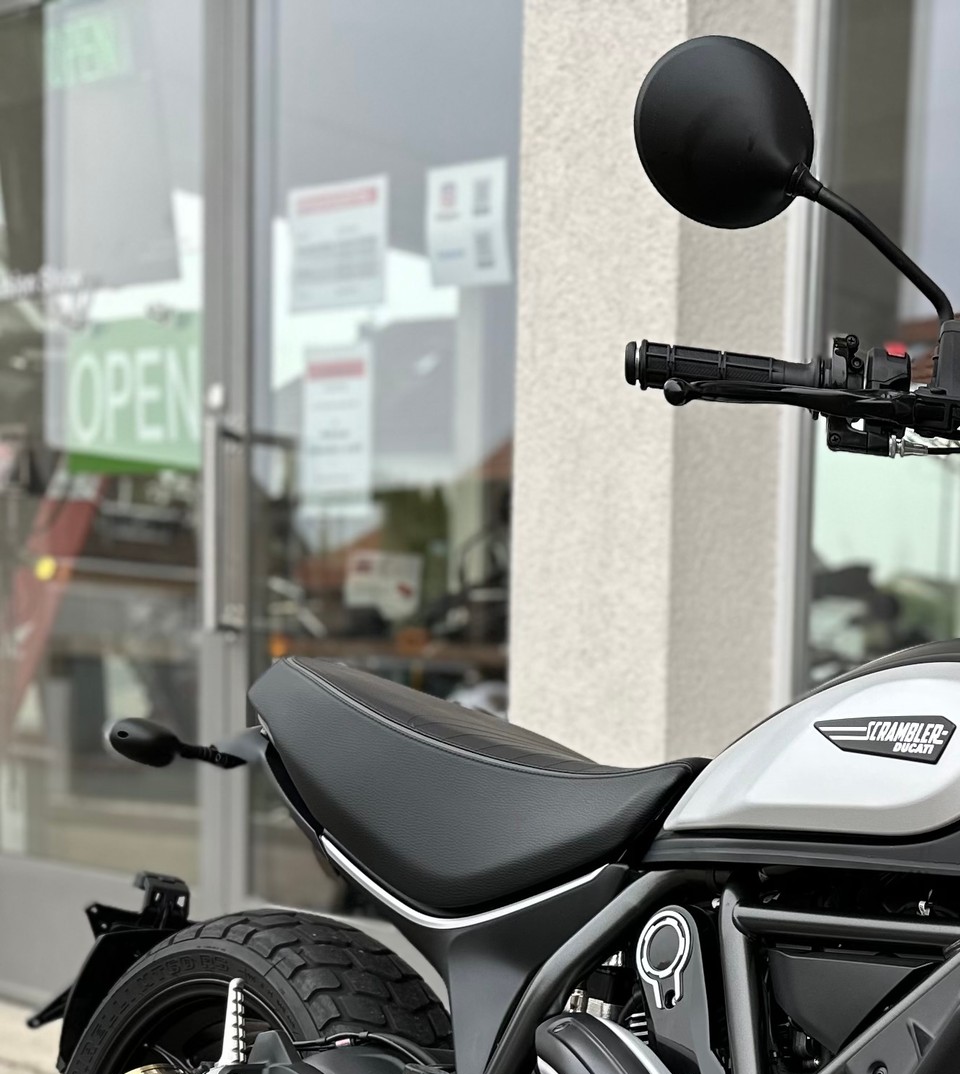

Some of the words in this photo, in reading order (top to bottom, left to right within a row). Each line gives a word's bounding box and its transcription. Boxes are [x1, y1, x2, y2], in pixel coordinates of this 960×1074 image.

[68, 346, 201, 446] OPEN
[866, 720, 946, 745] SCRAMBLER
[892, 742, 935, 755] DUCATI
